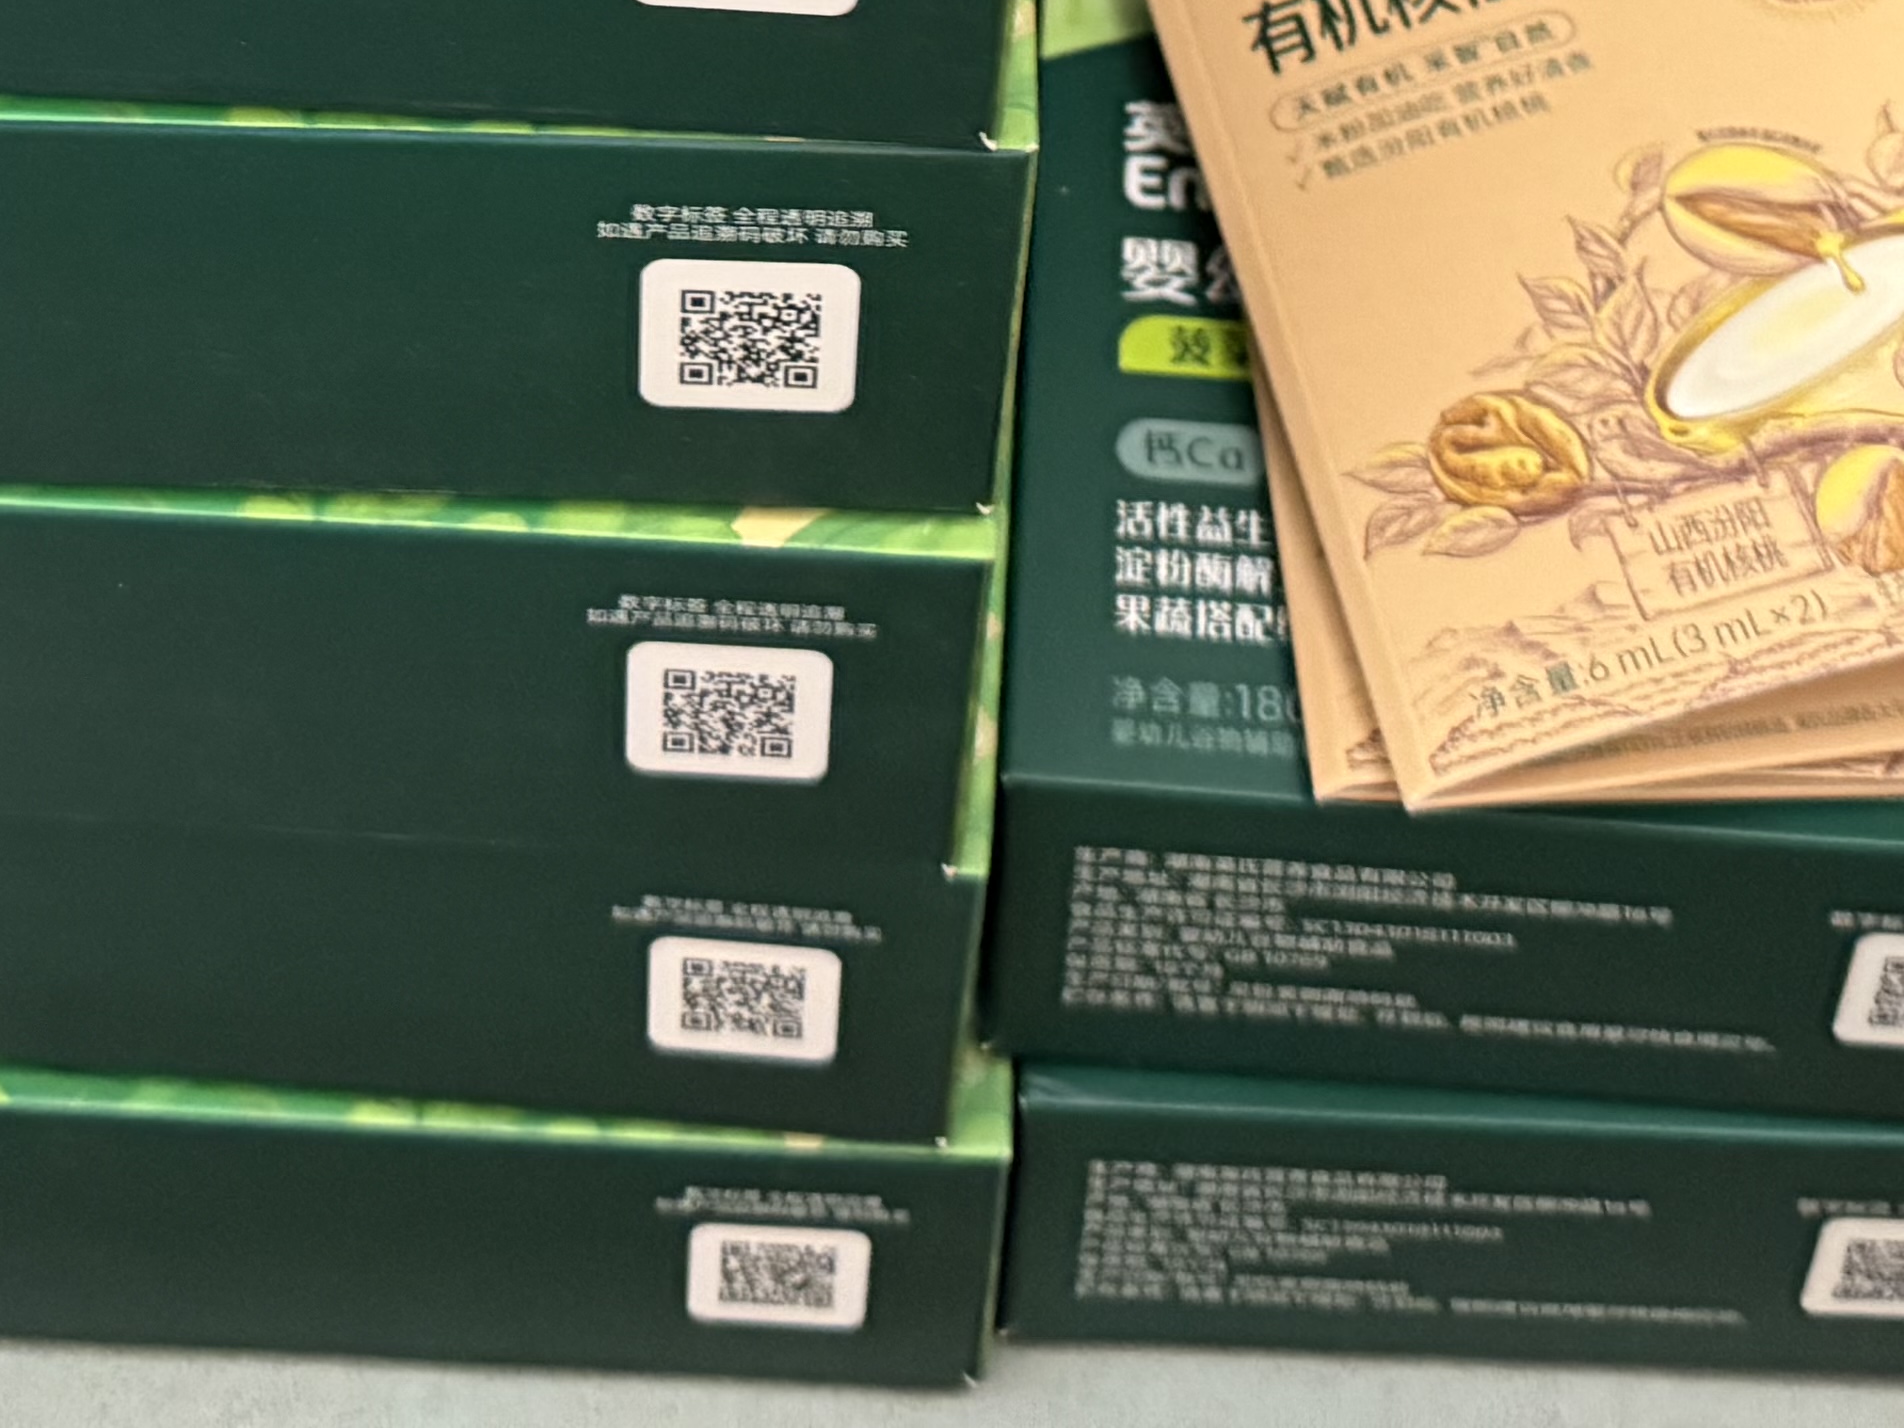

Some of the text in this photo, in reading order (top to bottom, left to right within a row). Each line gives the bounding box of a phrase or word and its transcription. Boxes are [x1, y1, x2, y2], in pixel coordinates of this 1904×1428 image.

[595, 219, 910, 249] 如遇产品追溯码破坏 请勿购买
[629, 201, 875, 230] 数字标签 全程透明追溯
[1143, 428, 1246, 473] 钙Ca
[1649, 498, 1773, 555] 山西汾阳
[1668, 537, 1790, 597] 有机核桃
